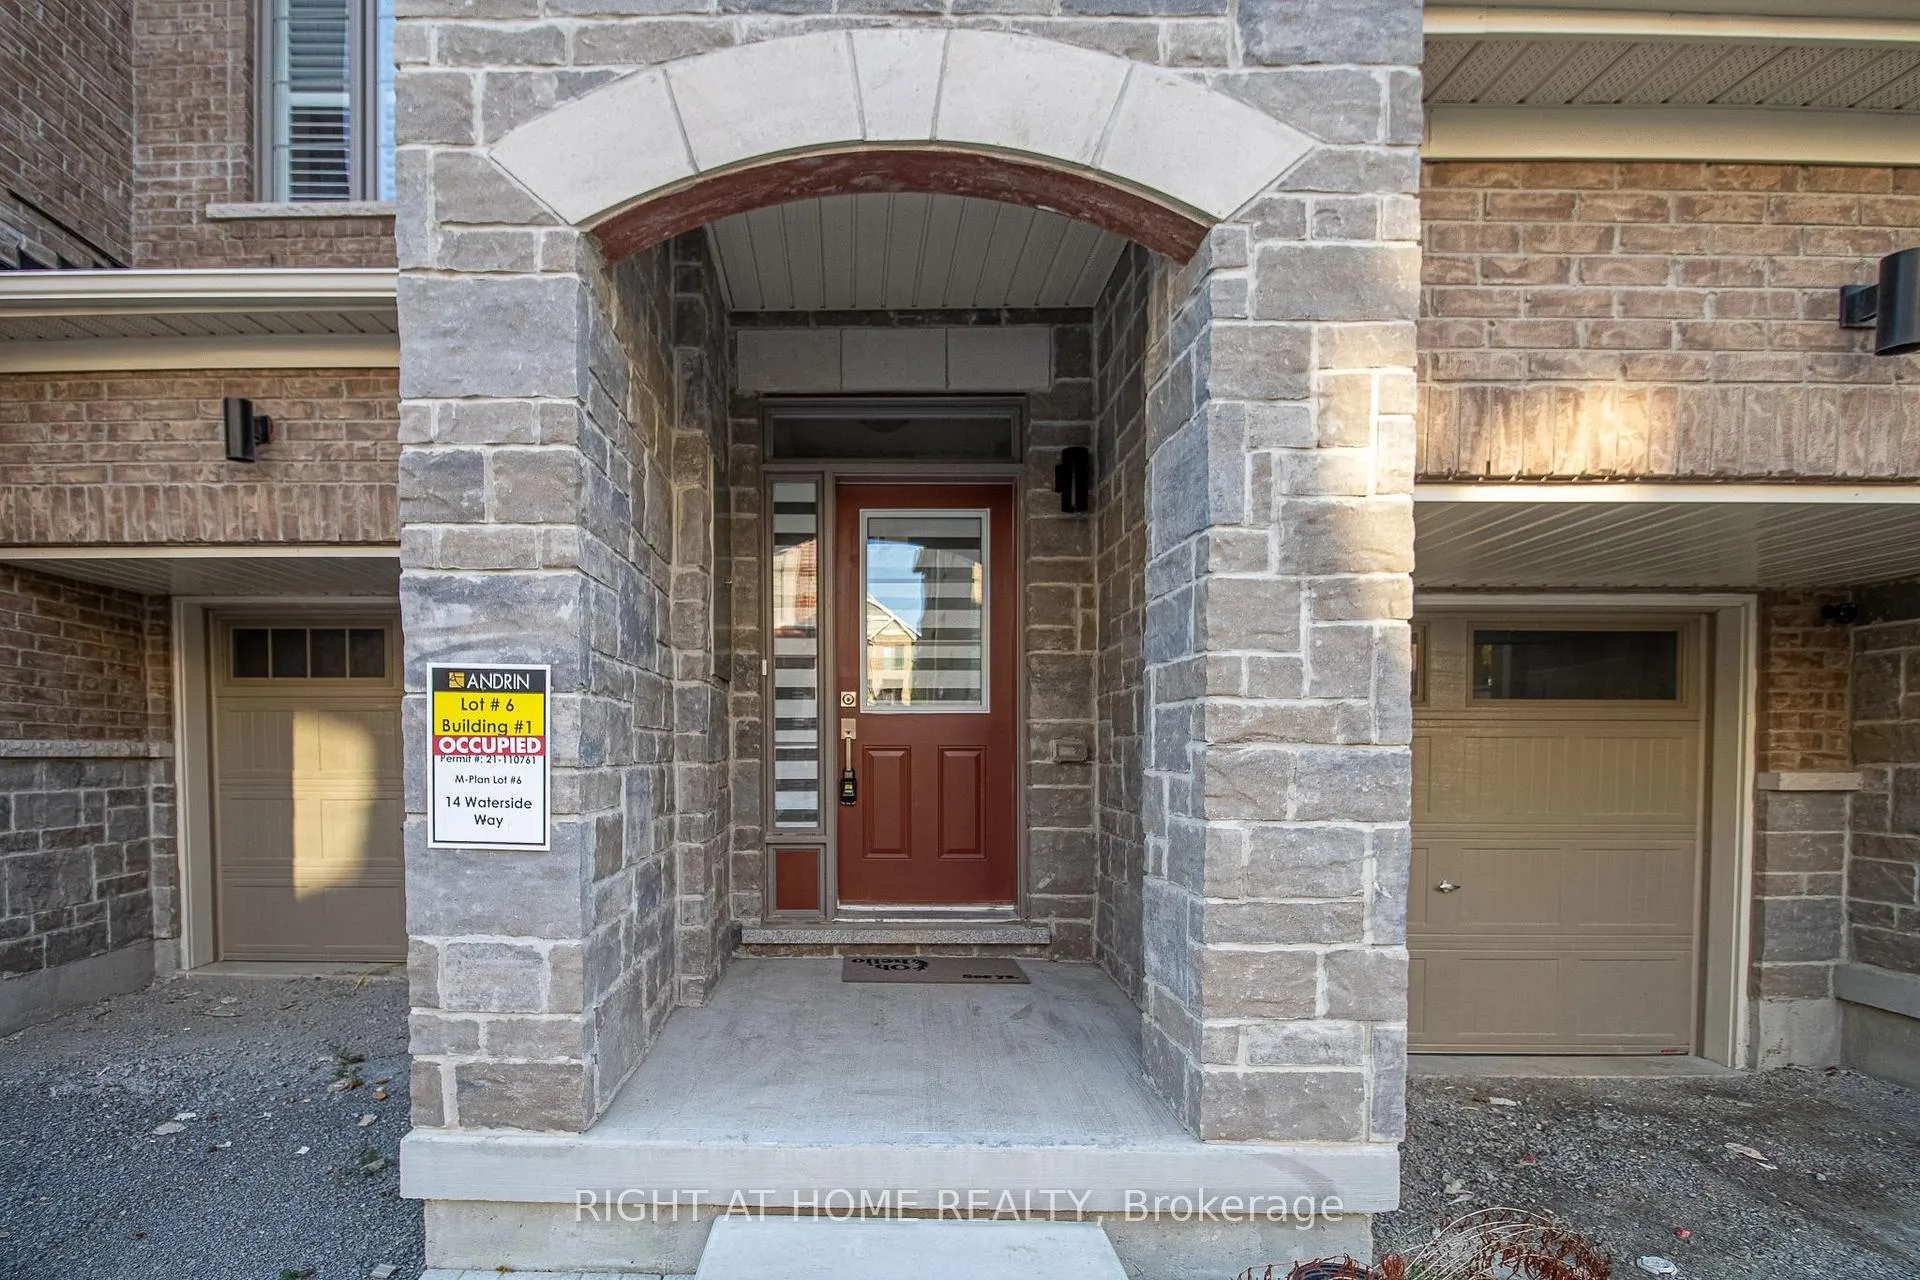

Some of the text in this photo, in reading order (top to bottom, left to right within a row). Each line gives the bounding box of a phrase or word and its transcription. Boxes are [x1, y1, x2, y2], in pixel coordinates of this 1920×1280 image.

[466, 673, 530, 690] ANDRIN
[461, 697, 514, 712] Lot # 6
[442, 719, 532, 735] Building #1
[438, 736, 542, 754] OCCUPIED
[440, 755, 471, 763] Permit
[454, 775, 522, 785] M-Plan Lot #6
[446, 796, 533, 809] 14 Waterside
[474, 814, 504, 829] Way
